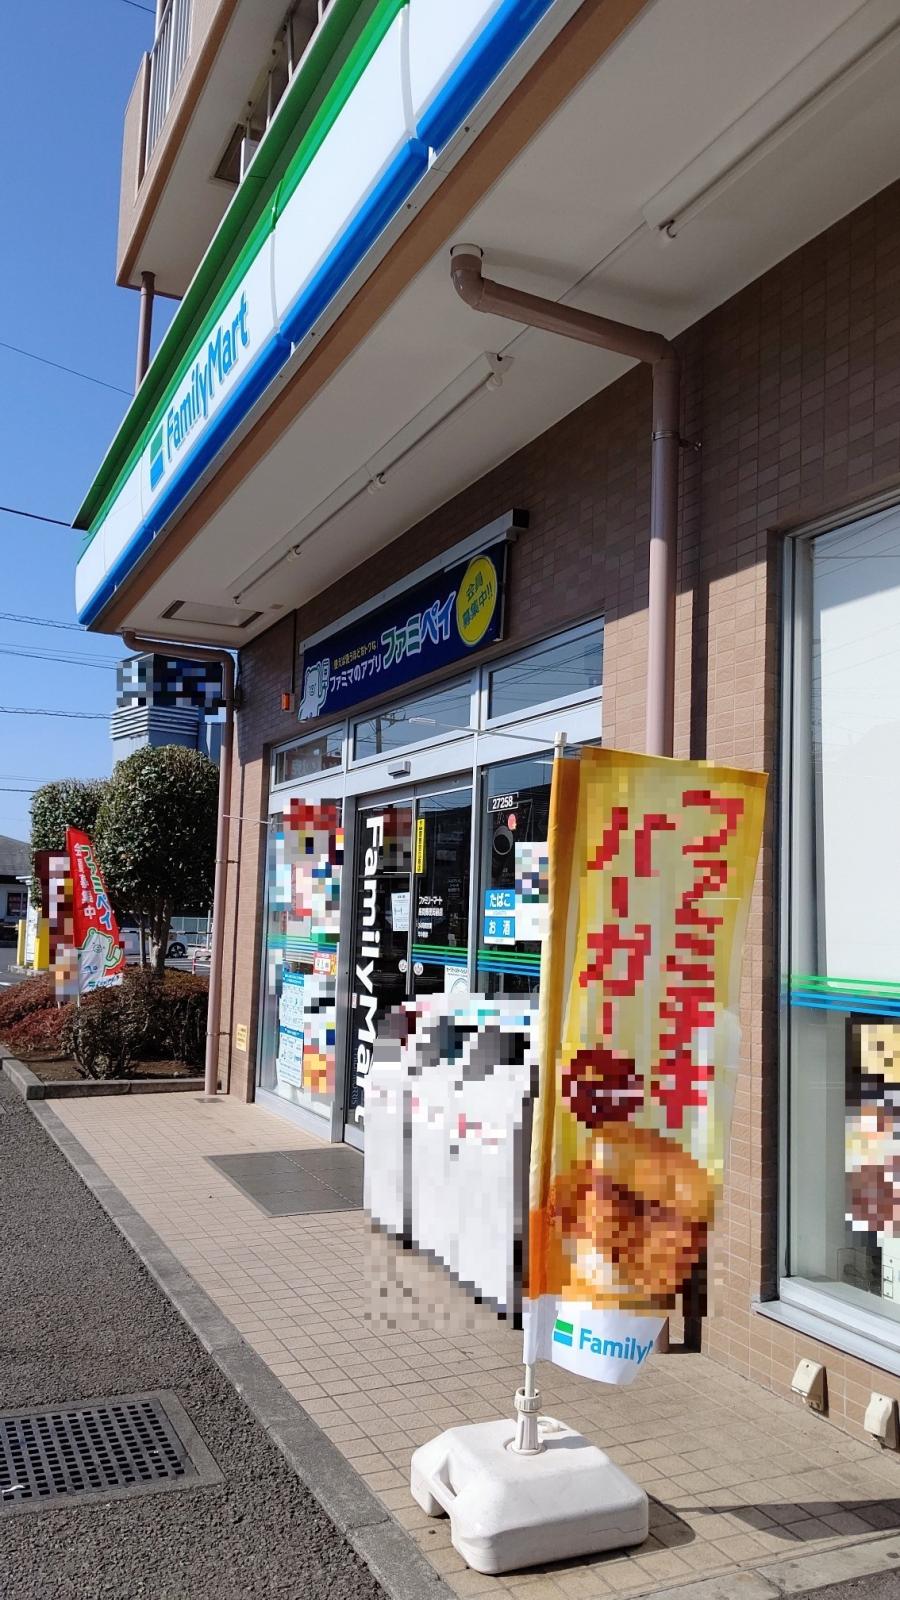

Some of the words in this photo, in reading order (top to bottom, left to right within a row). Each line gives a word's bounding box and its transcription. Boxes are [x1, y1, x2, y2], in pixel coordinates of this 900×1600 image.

[166, 290, 248, 461] FamilyMart
[380, 590, 457, 671] ファミペイ
[329, 653, 382, 693] ファミマのアプリ
[492, 795, 513, 810] 27258
[80, 844, 113, 931] ファミペイ
[489, 892, 511, 909] たばこ
[579, 1327, 654, 1365] Family
